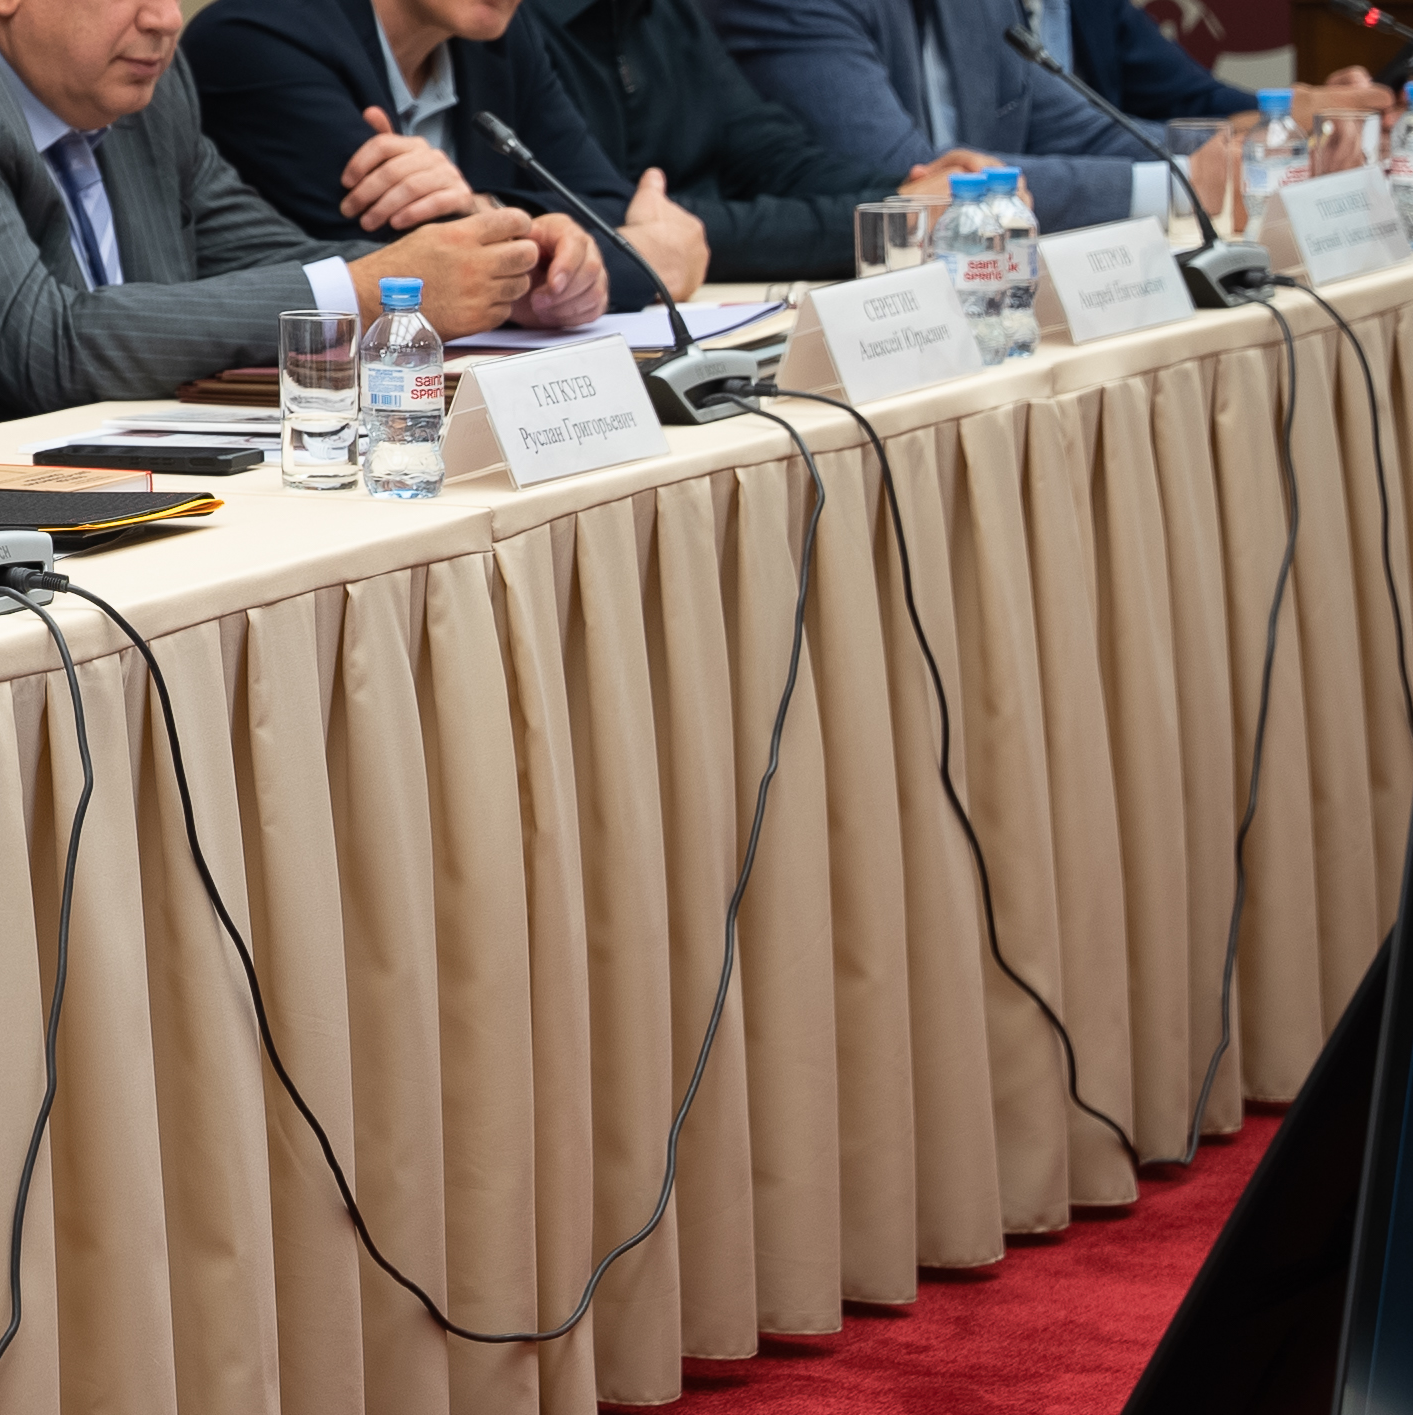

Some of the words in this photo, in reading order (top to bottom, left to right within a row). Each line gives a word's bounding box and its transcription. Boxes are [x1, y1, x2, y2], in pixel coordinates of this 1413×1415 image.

[863, 290, 920, 322] СЕРЕГИН
[858, 332, 902, 362] Алексей
[531, 375, 597, 407] ГАГКУЕВ
[519, 425, 564, 454] Руслан
[562, 411, 638, 445] Григорьевич
